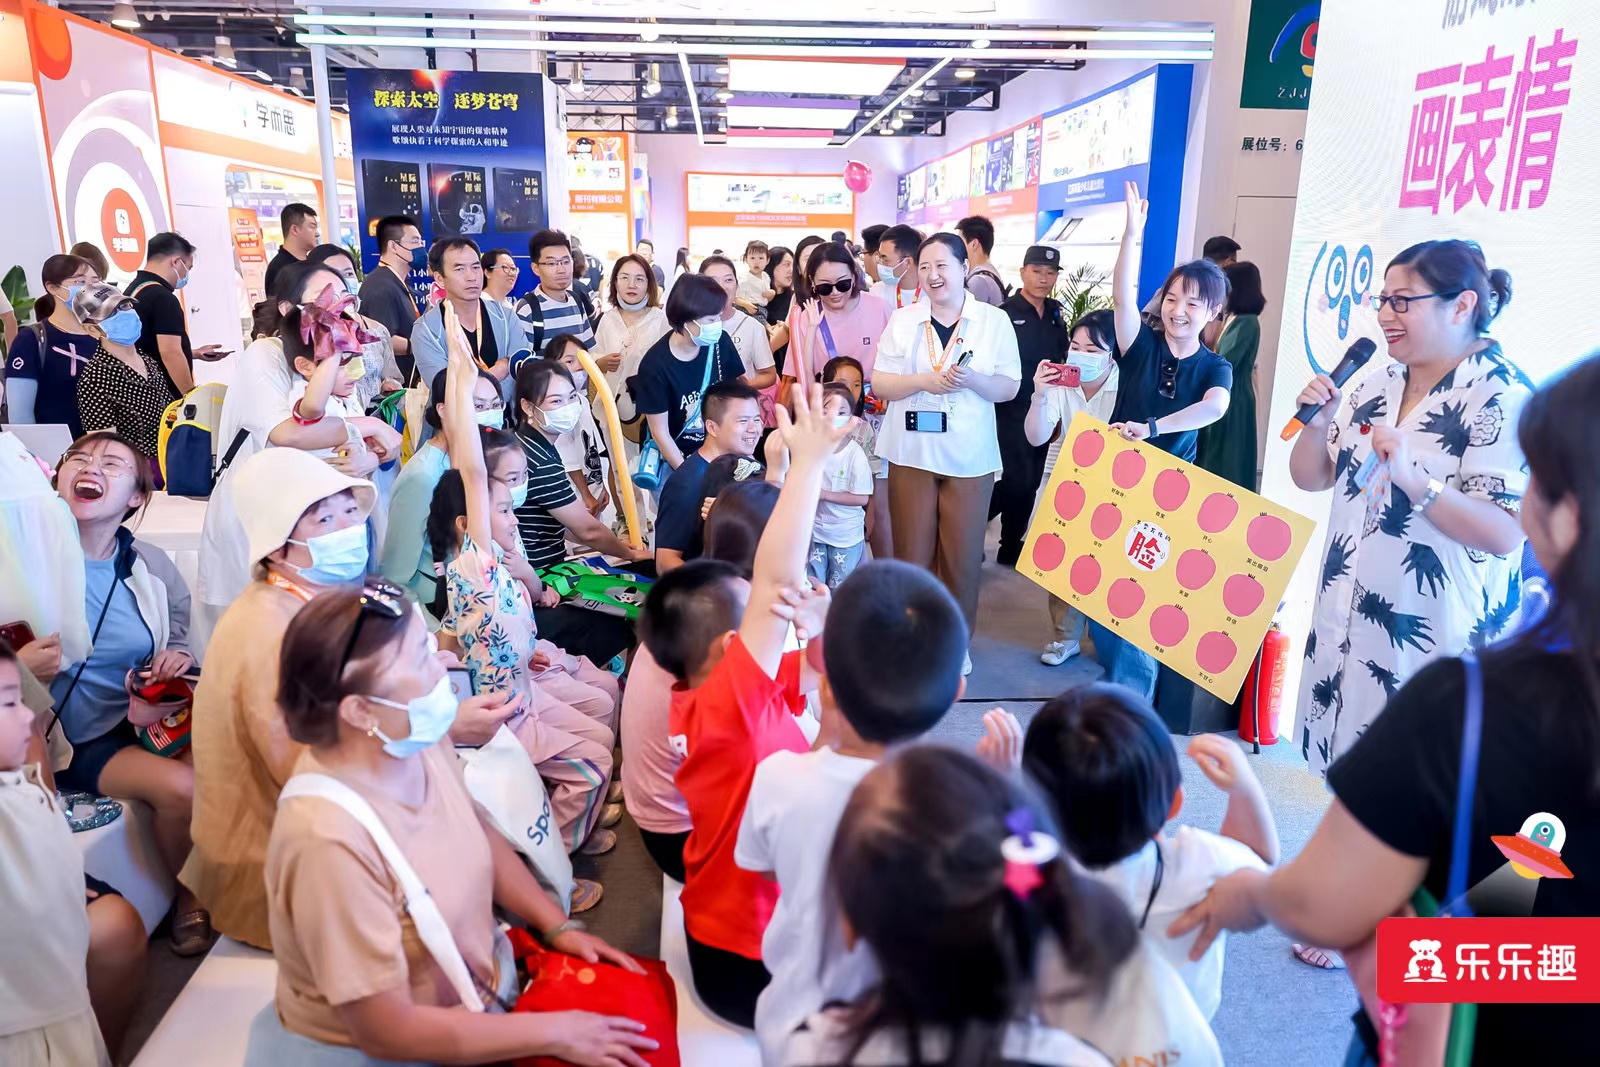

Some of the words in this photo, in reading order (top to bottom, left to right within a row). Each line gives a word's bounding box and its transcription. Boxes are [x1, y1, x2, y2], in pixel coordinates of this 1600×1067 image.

[374, 90, 440, 109] 探索太空
[453, 93, 519, 111] 逐梦苍穹
[255, 101, 296, 136] 学而思
[391, 124, 508, 136] 展现人类对未知宇宙的探索精神
[1398, 27, 1579, 215] 画表情
[391, 136, 509, 147] 歌颂执着于科学探索的人和事迹
[1127, 530, 1161, 570] 脸
